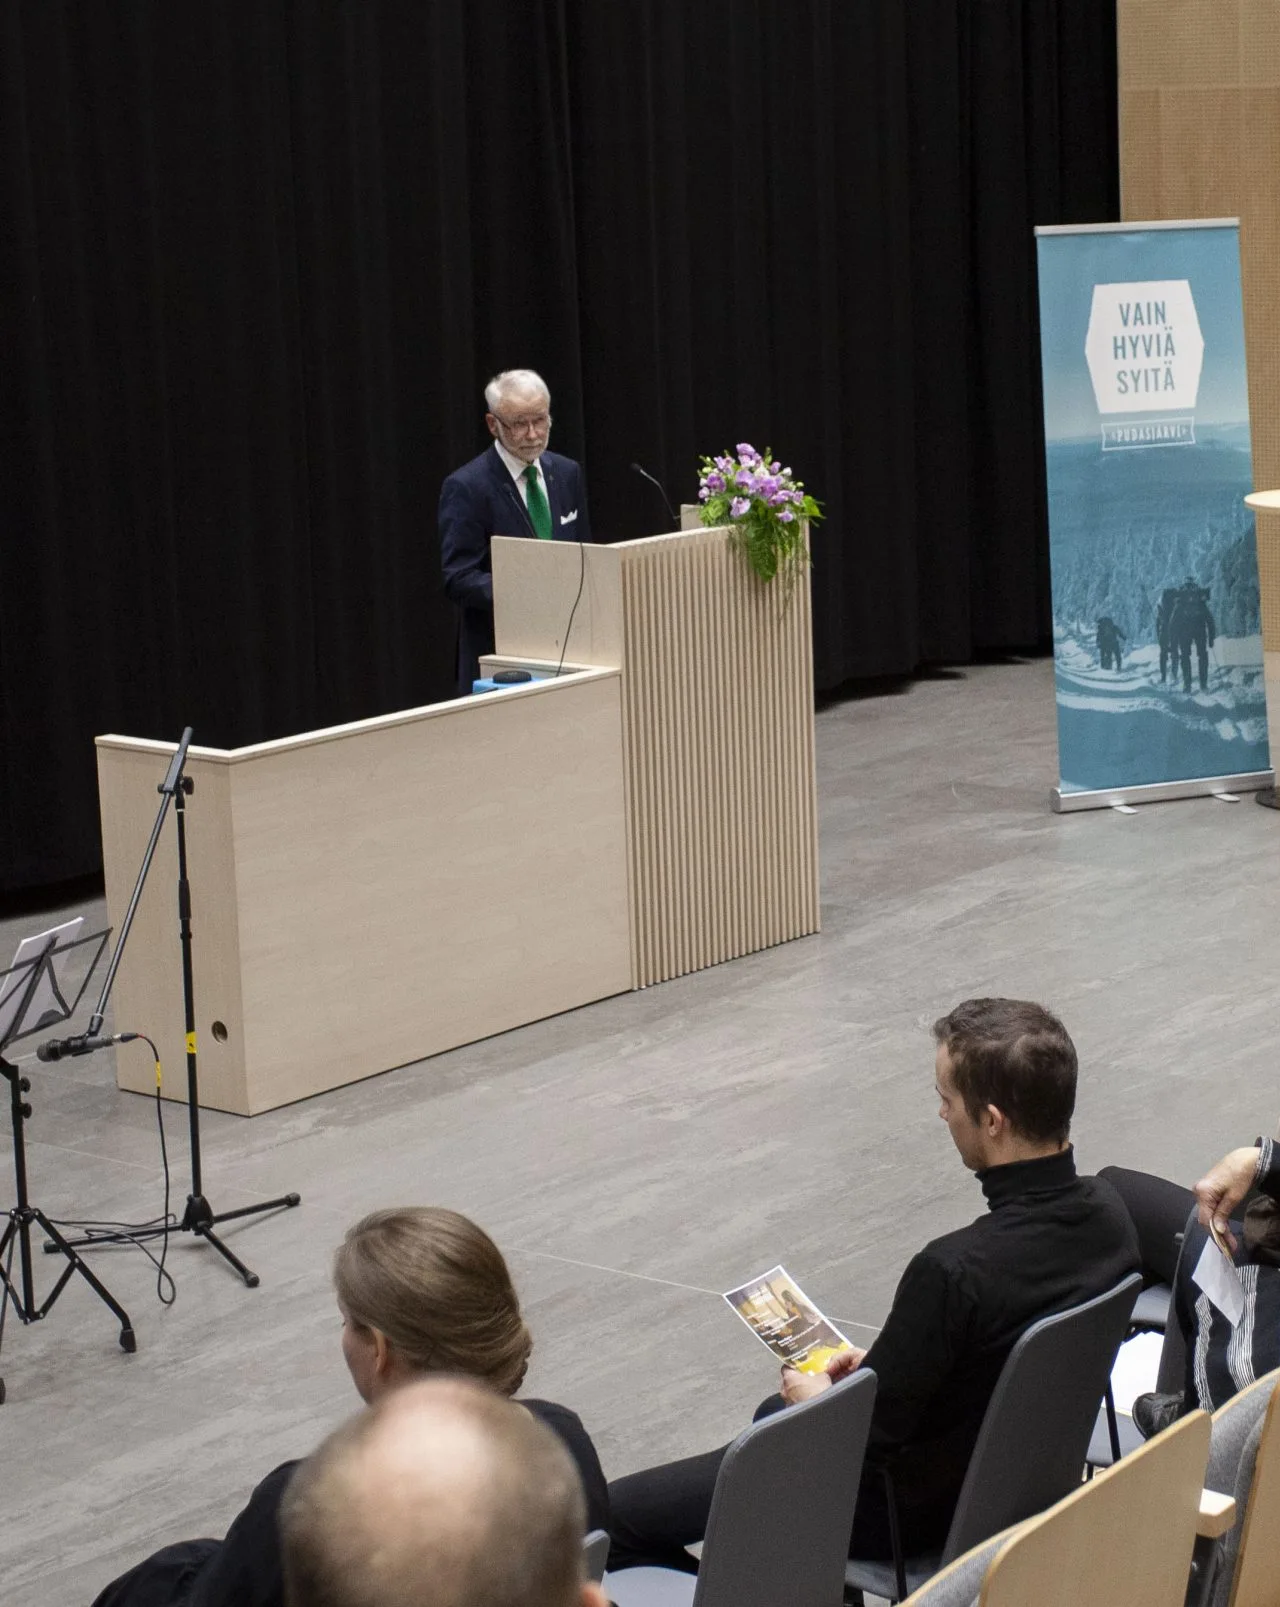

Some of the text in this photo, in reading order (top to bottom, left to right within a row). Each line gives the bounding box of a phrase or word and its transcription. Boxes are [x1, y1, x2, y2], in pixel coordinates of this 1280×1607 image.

[1119, 301, 1166, 327] VAIN
[1113, 326, 1176, 360] HYVIÄ
[1117, 360, 1175, 395] SYITÄ
